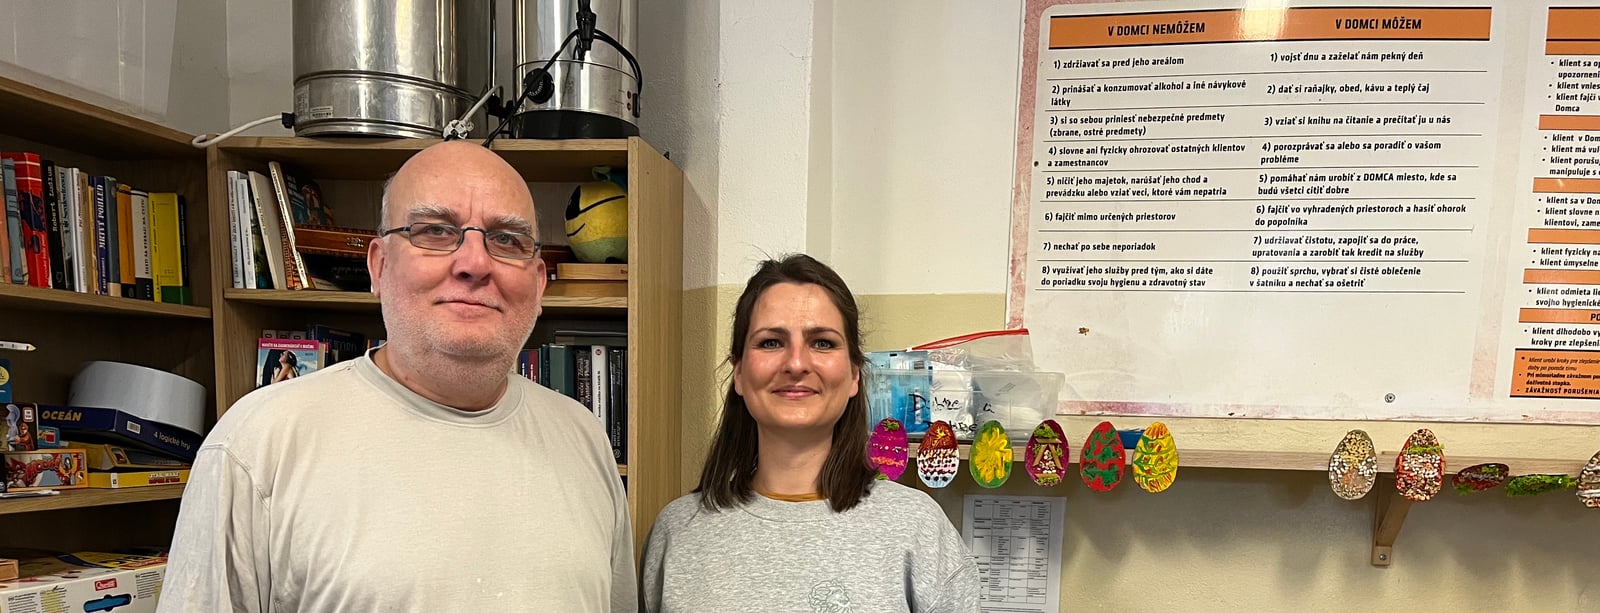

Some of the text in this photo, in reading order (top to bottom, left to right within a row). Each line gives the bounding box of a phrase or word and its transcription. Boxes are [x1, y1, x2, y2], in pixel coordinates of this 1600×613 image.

[1336, 19, 1342, 29] V
[1345, 19, 1378, 29] DOMCI
[1108, 26, 1114, 36] V
[1117, 25, 1149, 36] DOMCI
[1270, 52, 1278, 62] 1)
[1303, 52, 1319, 61] dnu
[1054, 59, 1061, 70] 1)
[1112, 58, 1130, 69] pred
[1132, 58, 1150, 68] jeho
[1052, 84, 1060, 95] 2)
[1154, 81, 1184, 90] alkohol
[1267, 84, 1276, 95] 2)
[1295, 84, 1302, 93] si
[1339, 84, 1362, 93] obed,
[1050, 115, 1058, 125] 3)
[1060, 116, 1067, 124] si
[1080, 116, 1103, 124] sebou
[1186, 112, 1225, 123] predmety
[1050, 128, 1081, 138] (zbrane,
[1105, 126, 1146, 137] predmety)
[1048, 146, 1057, 156] 4)
[1059, 147, 1084, 155] slovne
[1086, 146, 1098, 154] ani
[1100, 146, 1127, 156] fyzicky
[1212, 144, 1245, 152] klientov
[1047, 176, 1055, 186] 5)
[1076, 177, 1093, 186] jeho
[1095, 176, 1128, 186] majetok,
[1162, 176, 1180, 186] jeho
[1182, 175, 1201, 183] chod
[1259, 173, 1268, 183] 5)
[1363, 173, 1394, 181] DOMCA
[1396, 173, 1427, 182] miesto,
[1430, 173, 1445, 181] kde
[1132, 188, 1149, 197] veci,
[1193, 187, 1227, 197] nepatria
[1326, 186, 1349, 194] dobre
[1256, 205, 1265, 214] 6)
[1356, 204, 1403, 215] priestoroch
[1437, 204, 1466, 212] ohorok
[1045, 212, 1053, 222] 6)
[1136, 212, 1176, 222] priestorov
[1255, 218, 1265, 226] do
[1544, 219, 1579, 227] klientovi,
[1043, 242, 1051, 251] 7)
[1112, 242, 1156, 252] neporiadok
[1565, 248, 1591, 257] fyzicky
[1251, 266, 1259, 276] 8)
[1290, 267, 1319, 276] sprchu,
[1350, 267, 1357, 275] si
[42, 410, 82, 421] OCEÁN
